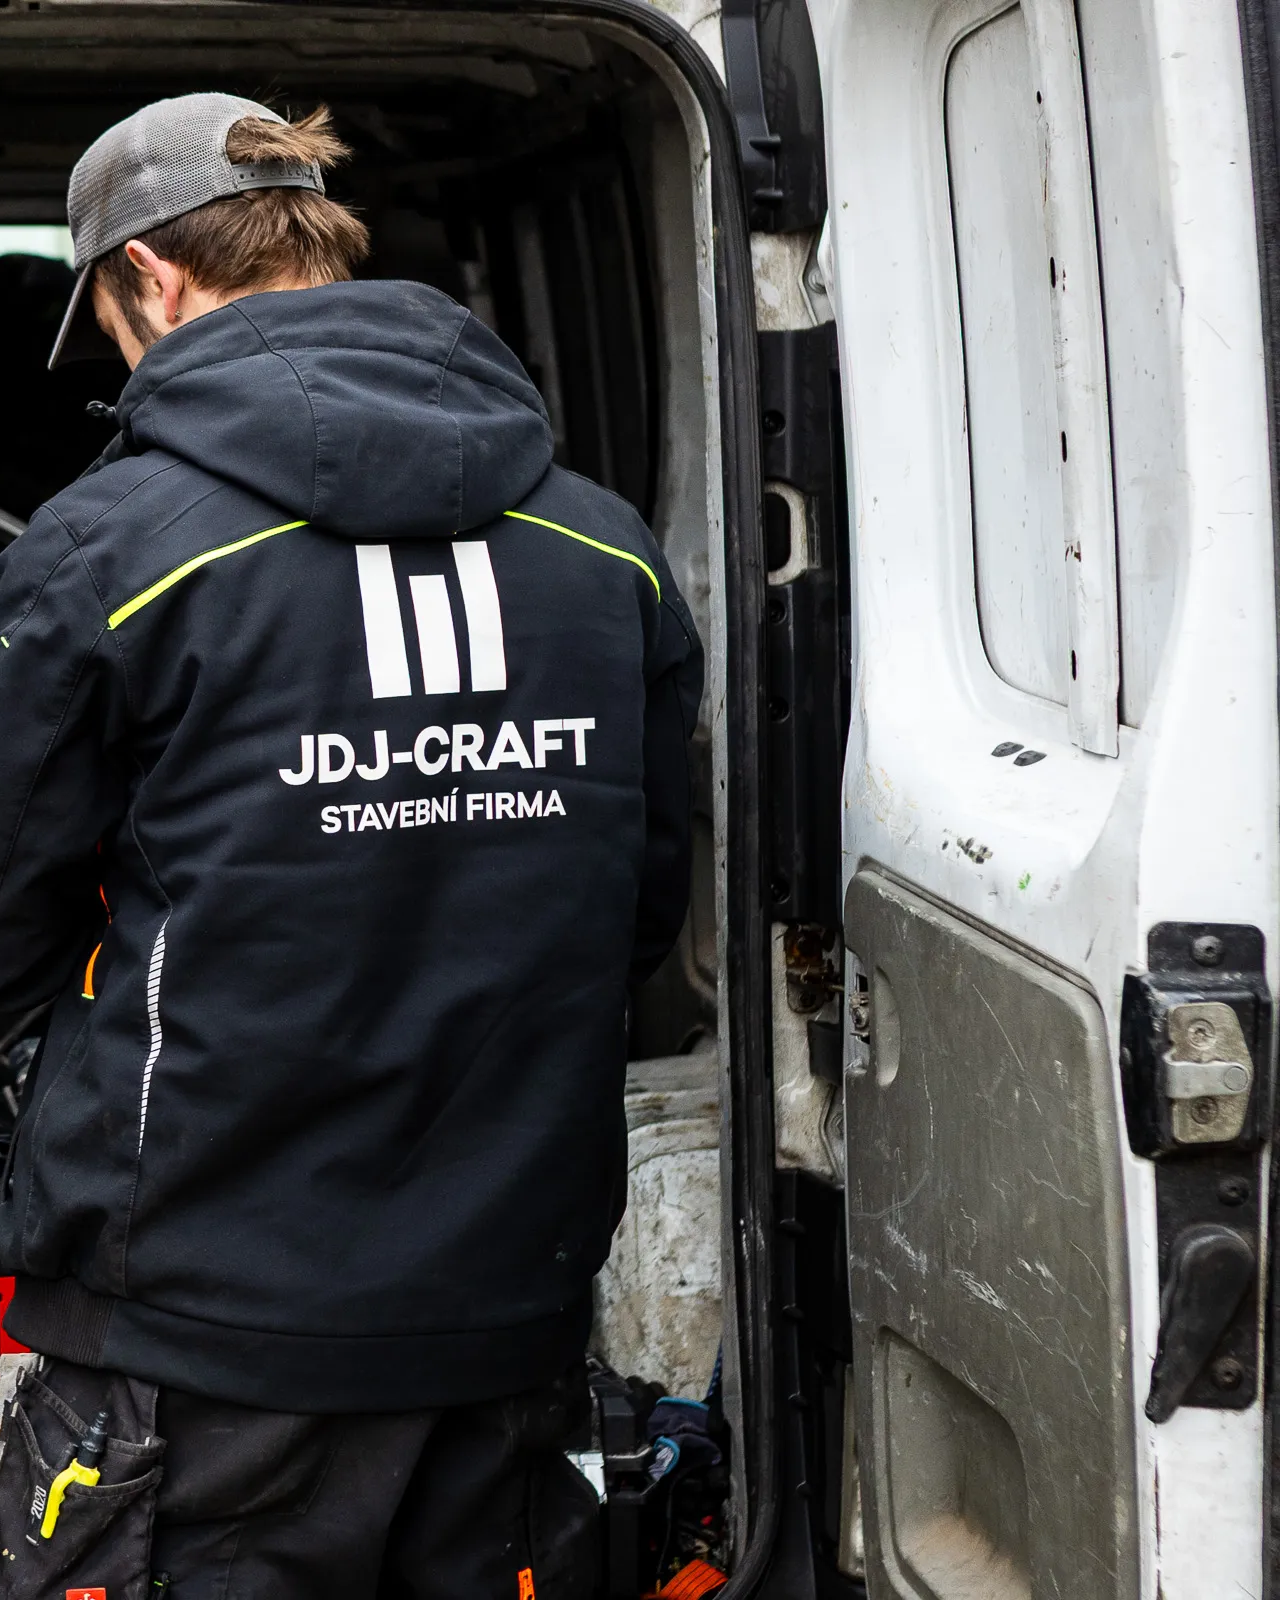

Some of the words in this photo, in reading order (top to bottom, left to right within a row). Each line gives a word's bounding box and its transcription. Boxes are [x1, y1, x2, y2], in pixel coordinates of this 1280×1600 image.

[278, 717, 596, 786] JDJ-CRAFT
[320, 786, 458, 834] STAVEBNÍ
[466, 789, 567, 821] FIRMA
[30, 1484, 47, 1521] 2020
